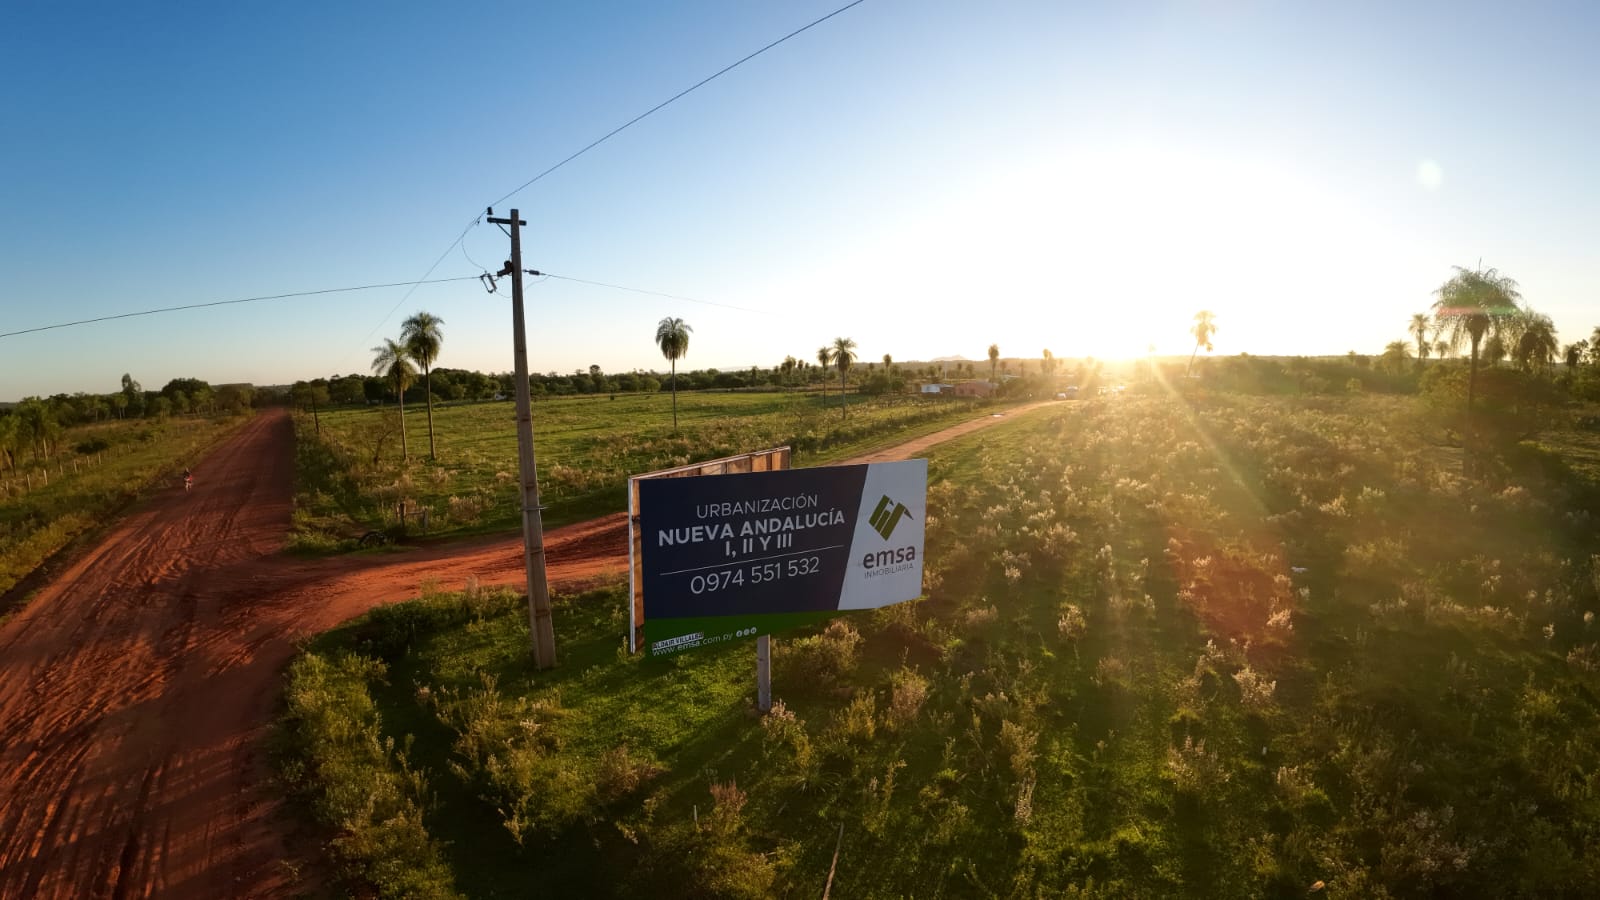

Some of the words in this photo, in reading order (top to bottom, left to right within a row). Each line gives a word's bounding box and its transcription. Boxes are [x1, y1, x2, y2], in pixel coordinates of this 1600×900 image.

[696, 493, 818, 518] URBANIZACIÓN
[658, 523, 735, 546] NUEVA
[740, 508, 845, 537] ANDALUCÍA
[725, 541, 737, 558] I,
[743, 538, 753, 553] II
[760, 536, 772, 551] Y
[777, 533, 792, 548] III
[863, 546, 915, 569] emsa
[690, 569, 744, 594] 0974
[751, 563, 780, 584] 551
[788, 557, 820, 577] 532
[864, 563, 914, 579] INMOBILIARIA
